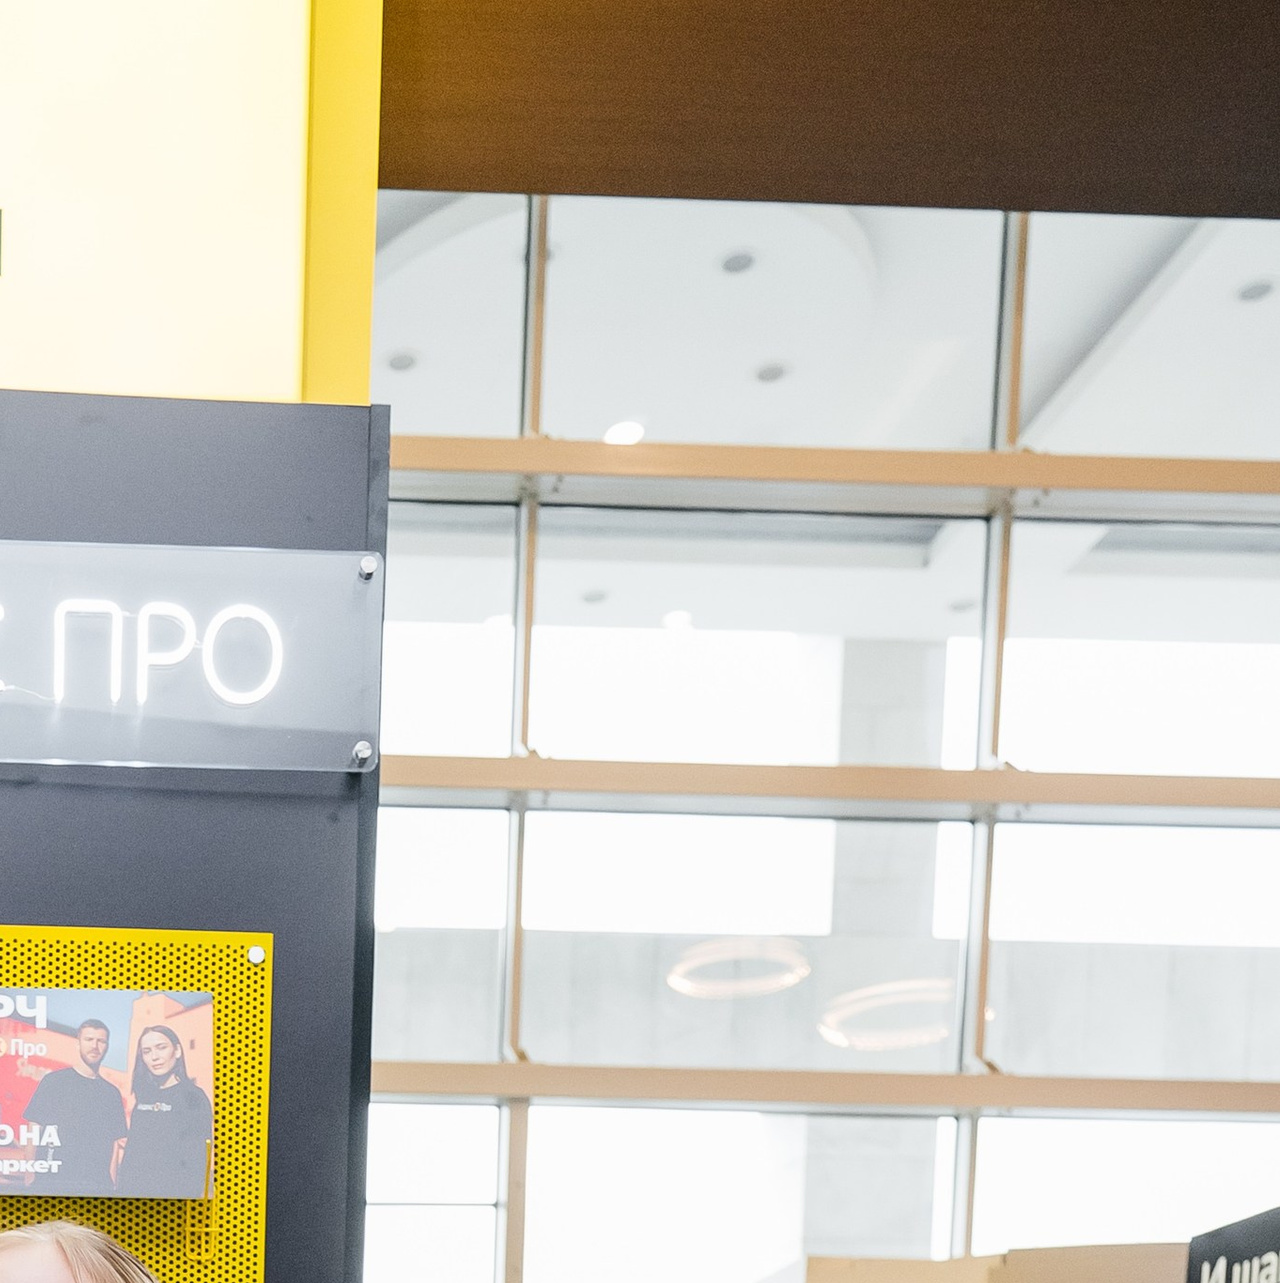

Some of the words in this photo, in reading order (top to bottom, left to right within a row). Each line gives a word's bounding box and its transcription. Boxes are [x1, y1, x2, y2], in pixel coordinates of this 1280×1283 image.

[53, 597, 284, 705] ПРО
[10, 1038, 48, 1059] Про
[19, 1125, 62, 1147] НА
